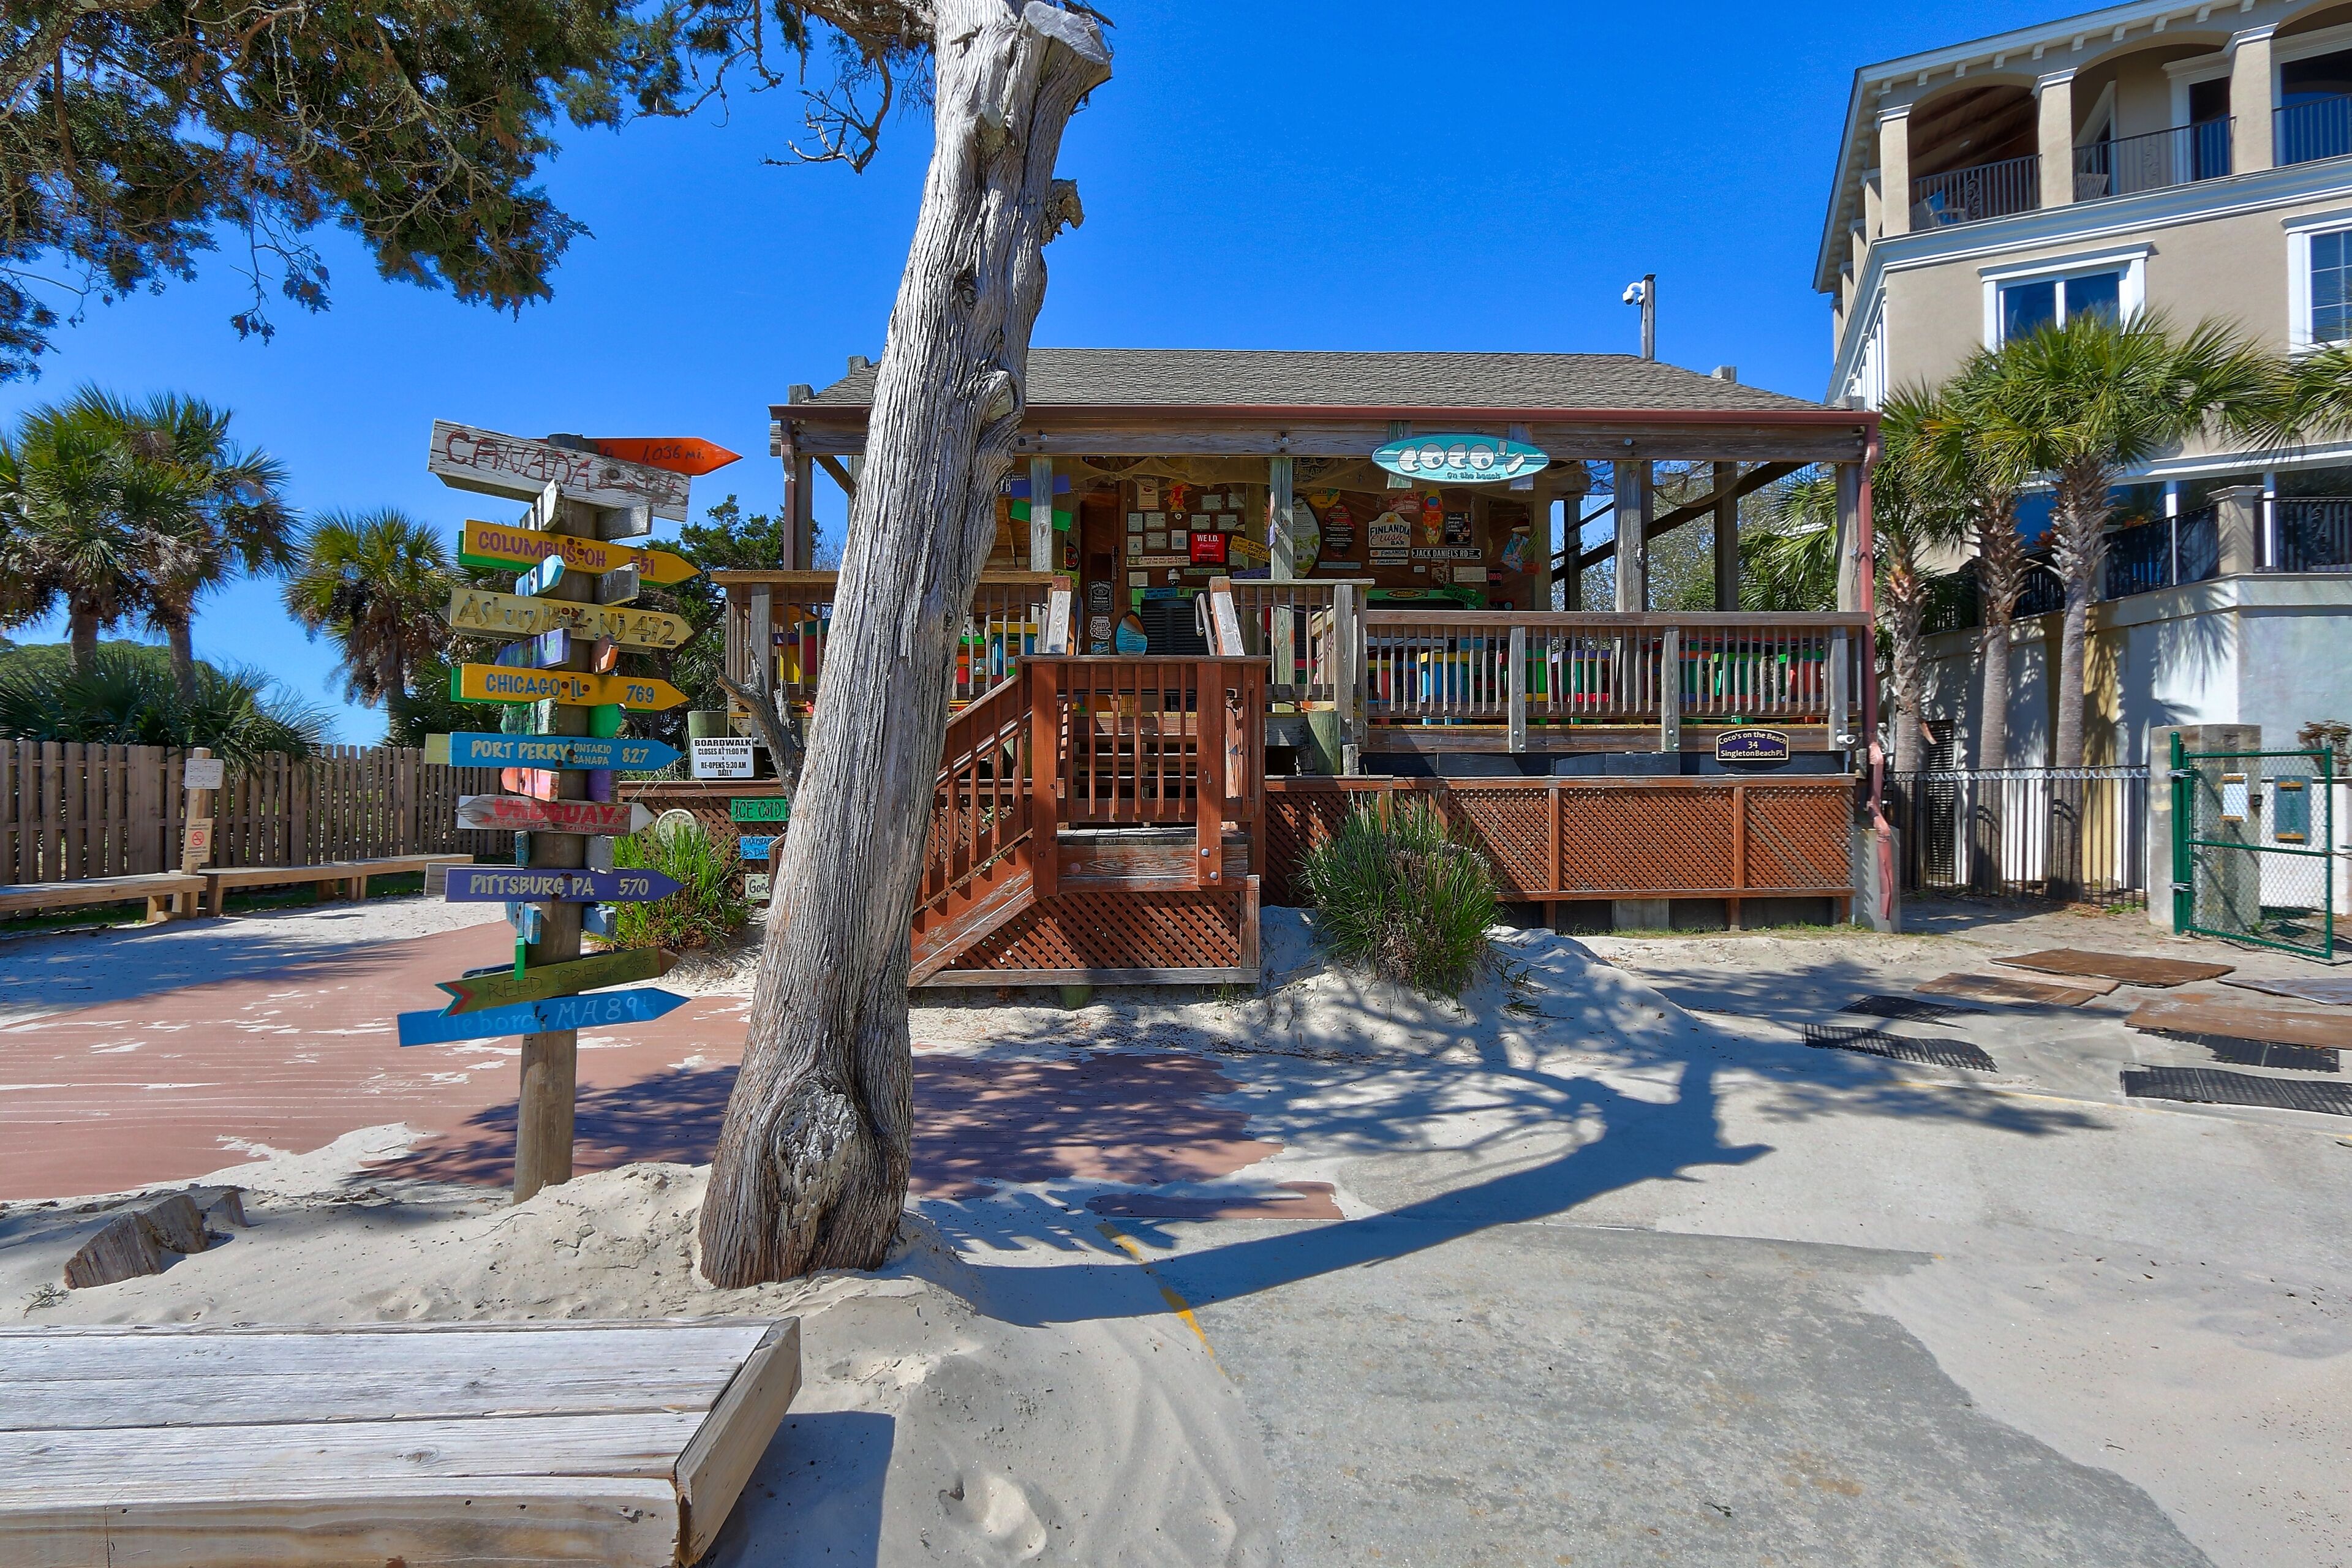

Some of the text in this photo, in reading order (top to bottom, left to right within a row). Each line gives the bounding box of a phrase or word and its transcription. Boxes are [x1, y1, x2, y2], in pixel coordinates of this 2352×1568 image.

[446, 429, 594, 491] CANADA
[1370, 524, 1411, 538] FINLANDIA
[584, 548, 606, 567] OH
[629, 616, 676, 646] 472
[570, 676, 586, 698] IL
[626, 684, 655, 704] 769
[1719, 733, 1742, 745] Coco's
[1766, 732, 1787, 745] Beach
[470, 739, 571, 761] PORT PERRY
[573, 743, 612, 754] ONTARIO
[622, 747, 649, 764] 827
[1721, 749, 1755, 759] Singleton
[189, 764, 221, 773] SHUTTLE
[572, 755, 609, 766] CANADA
[736, 801, 755, 818] ICE
[572, 877, 595, 896] PA
[618, 877, 649, 896] 570
[488, 962, 622, 1001] REED CREEK
[556, 999, 599, 1025] MA
